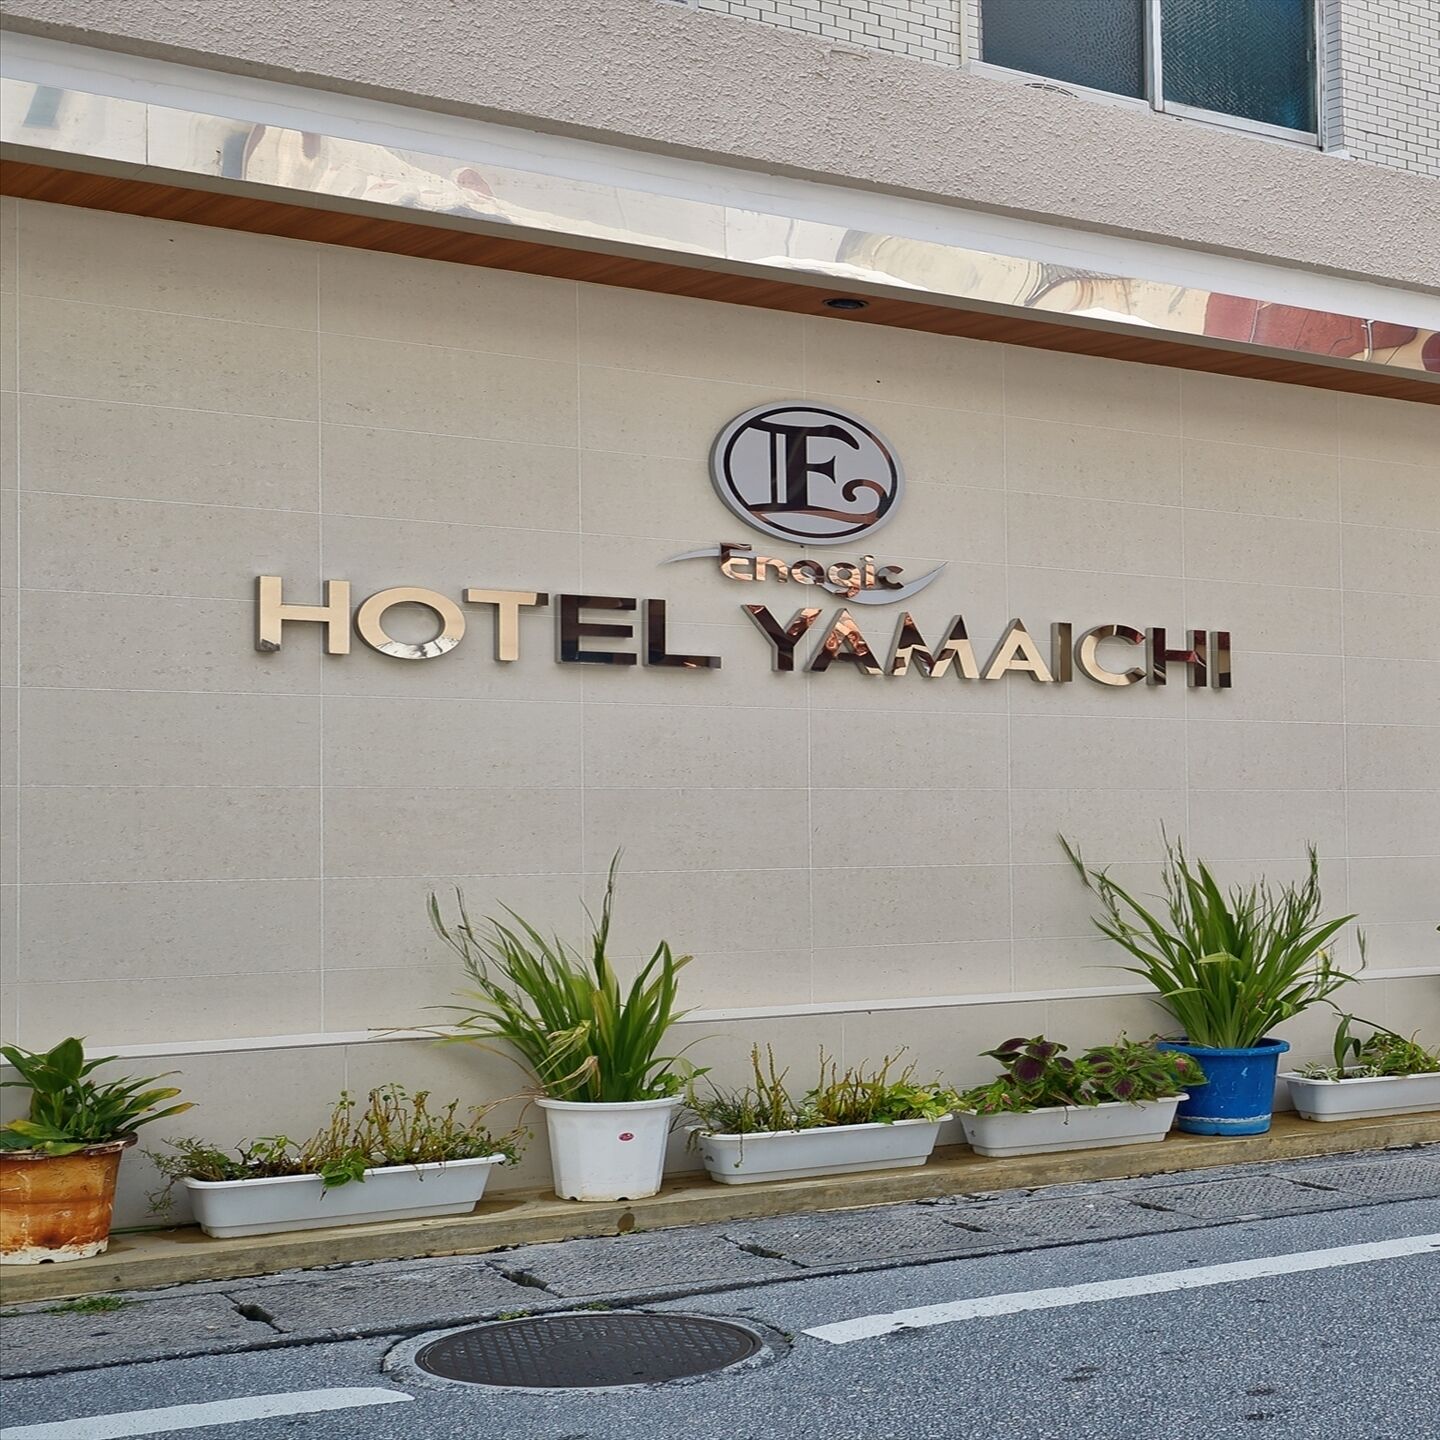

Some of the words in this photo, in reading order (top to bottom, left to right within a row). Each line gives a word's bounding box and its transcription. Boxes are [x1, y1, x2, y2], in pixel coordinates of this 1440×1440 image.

[720, 542, 904, 598] Enagic
[254, 575, 722, 671] HOTEL
[741, 603, 1231, 689] YAMAICHI
